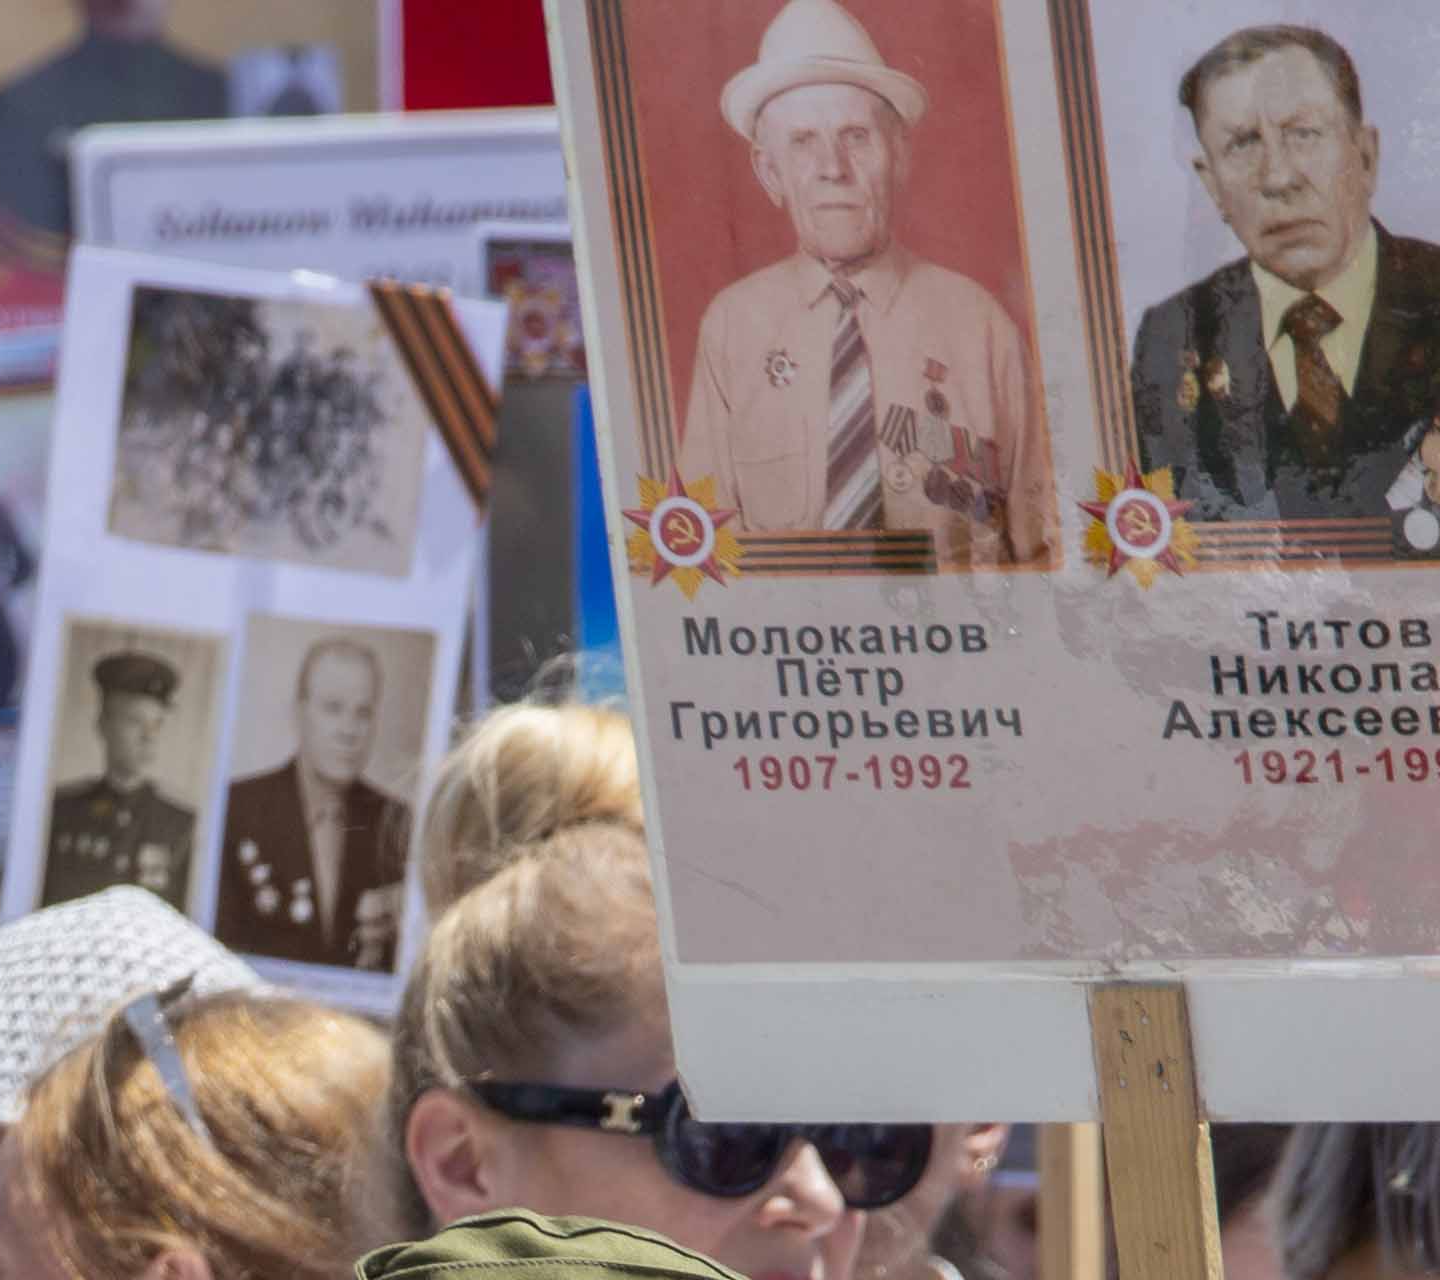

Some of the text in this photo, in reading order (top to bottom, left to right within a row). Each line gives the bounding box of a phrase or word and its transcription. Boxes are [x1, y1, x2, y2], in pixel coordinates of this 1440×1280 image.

[683, 616, 988, 656] Молоканов
[1246, 610, 1432, 651] Титов
[776, 658, 904, 706] Пётр
[670, 701, 1024, 750] Григорьевич
[733, 754, 972, 791] 1907-1992
